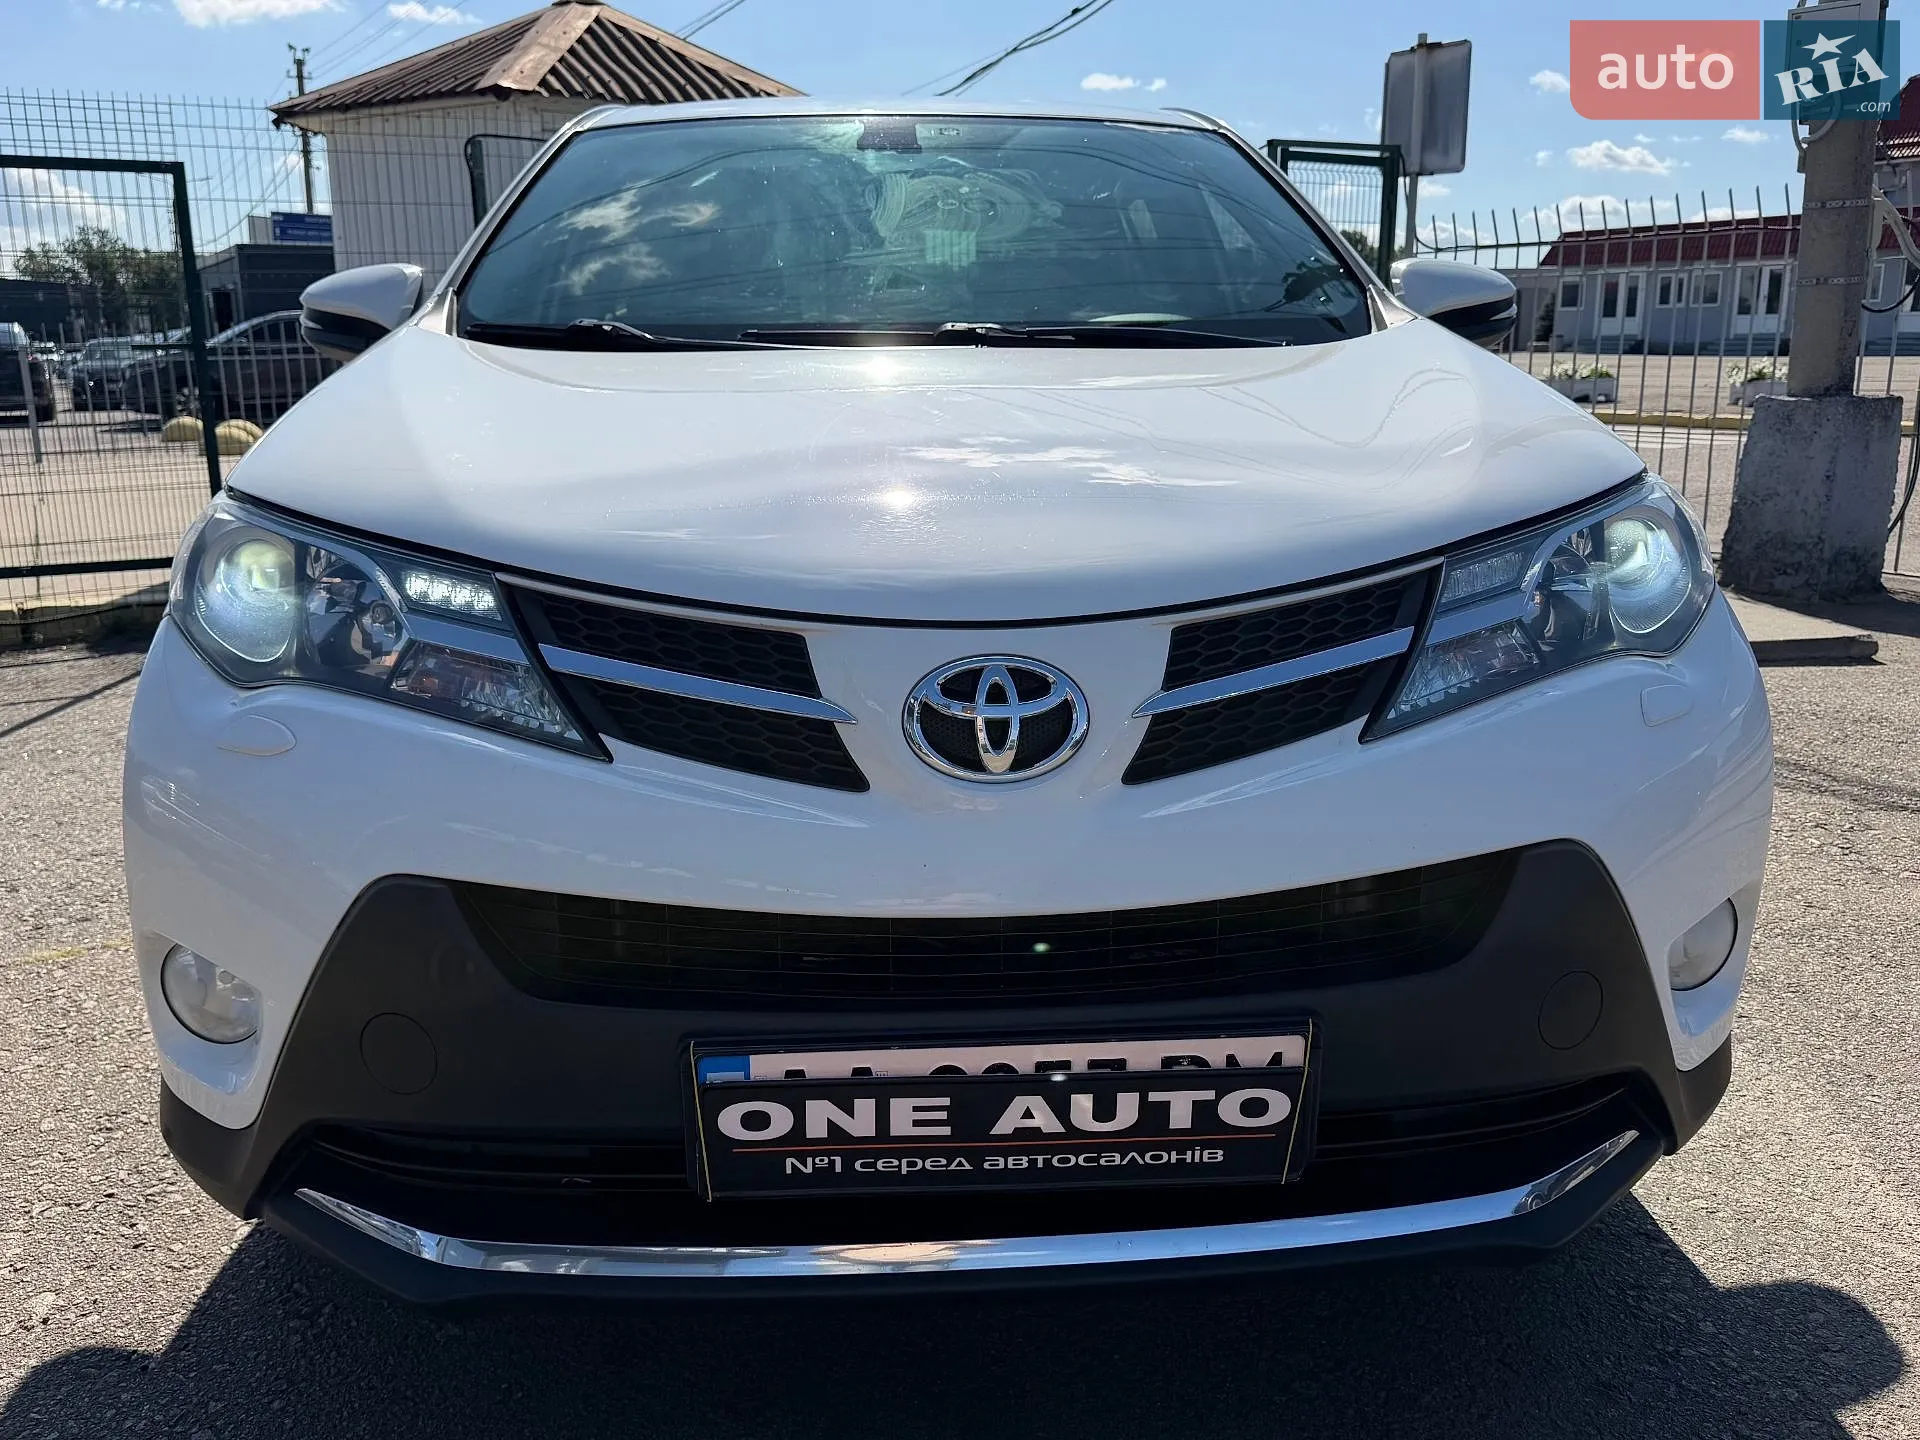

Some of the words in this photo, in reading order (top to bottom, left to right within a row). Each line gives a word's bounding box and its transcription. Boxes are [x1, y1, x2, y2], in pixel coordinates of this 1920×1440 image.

[716, 1096, 952, 1140] ONE
[989, 1087, 1291, 1135] AUTO
[854, 1151, 973, 1174] серед
[983, 1146, 1224, 1169] автосалонів
